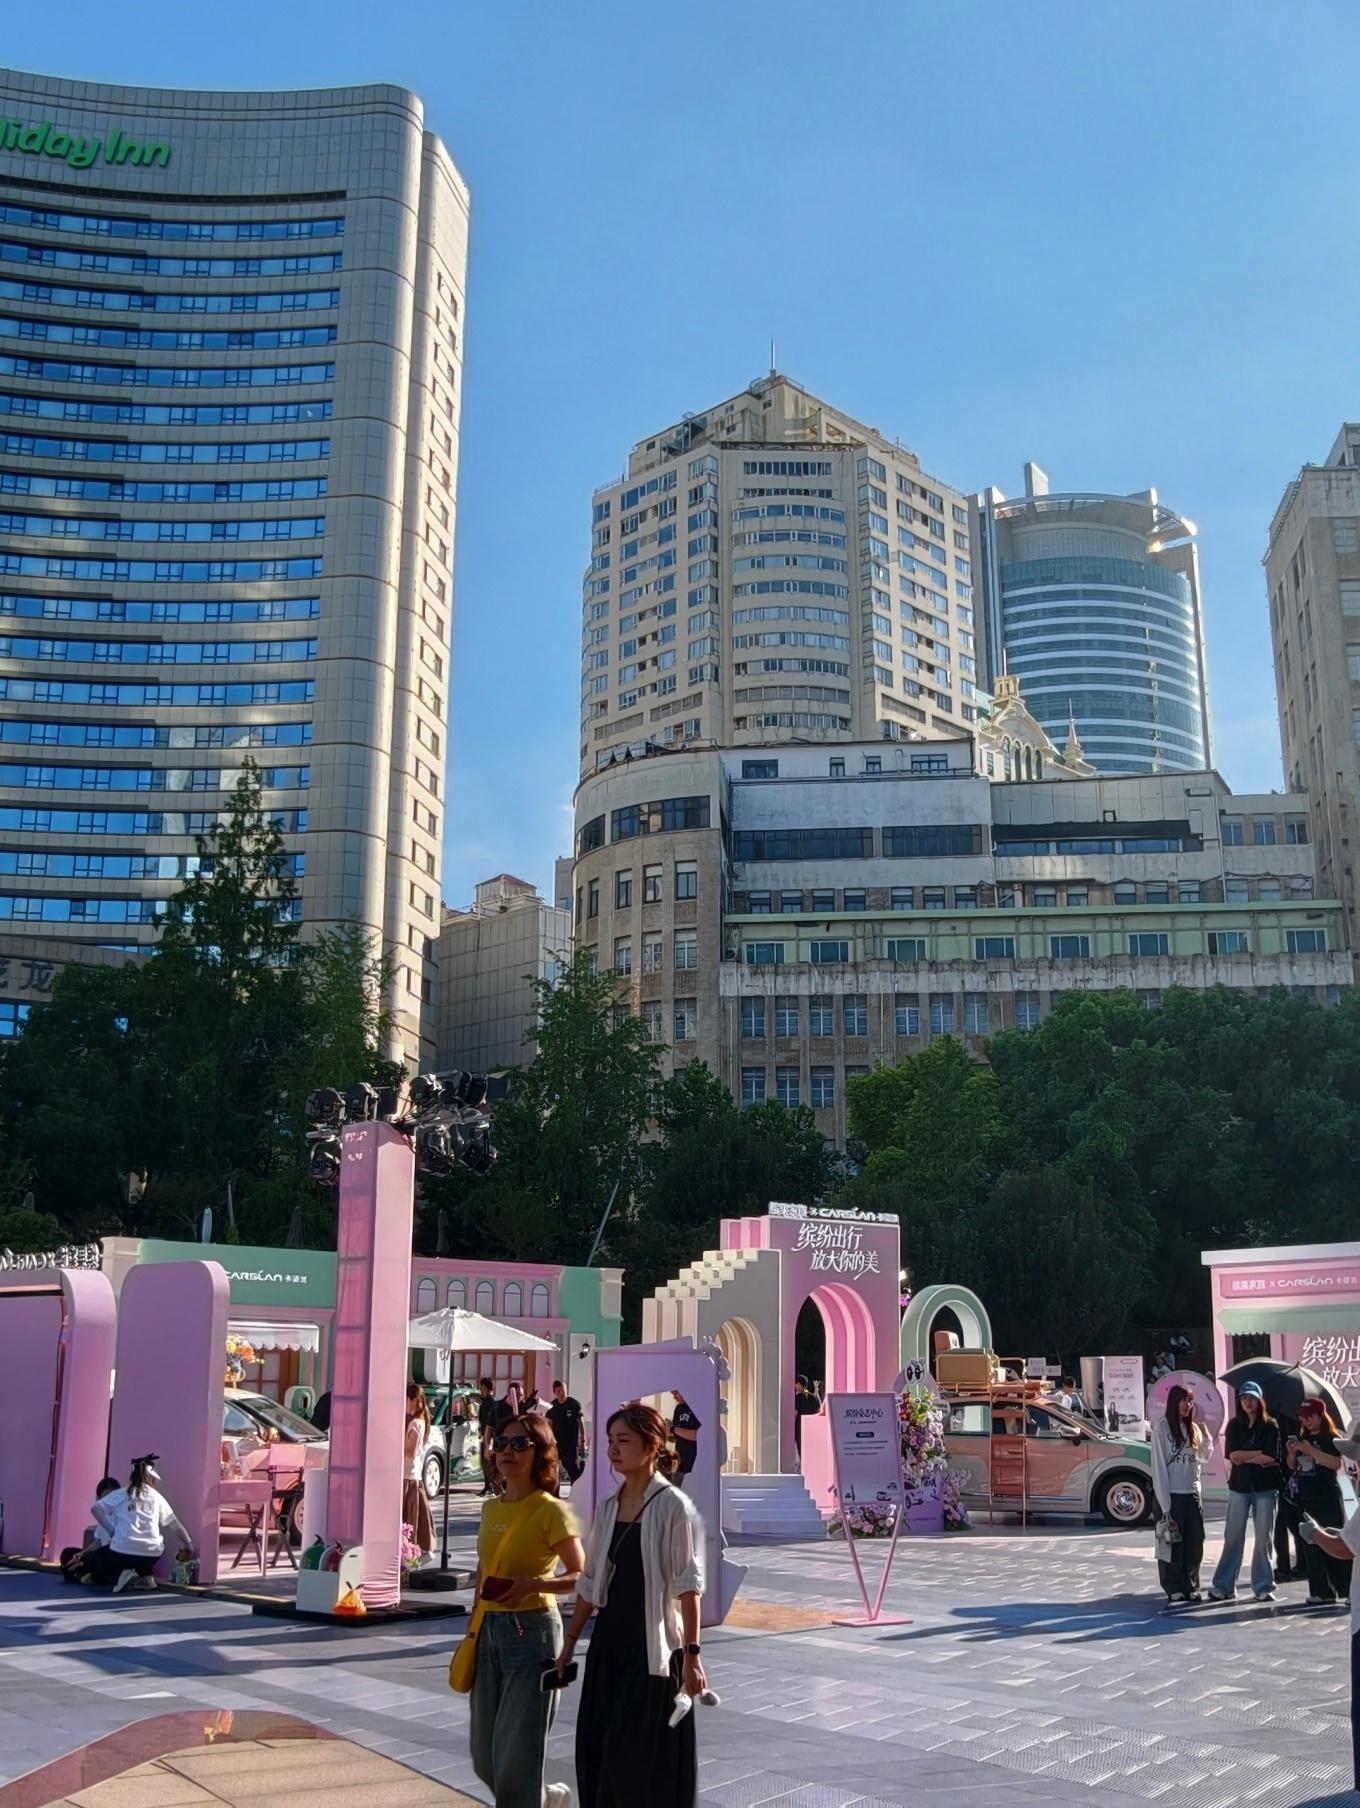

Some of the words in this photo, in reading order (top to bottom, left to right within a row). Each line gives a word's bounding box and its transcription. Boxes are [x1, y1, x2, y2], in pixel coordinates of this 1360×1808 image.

[105, 128, 171, 168] Inn
[791, 1222, 864, 1252] 缤纷出行
[809, 1250, 881, 1281] 放大你的美
